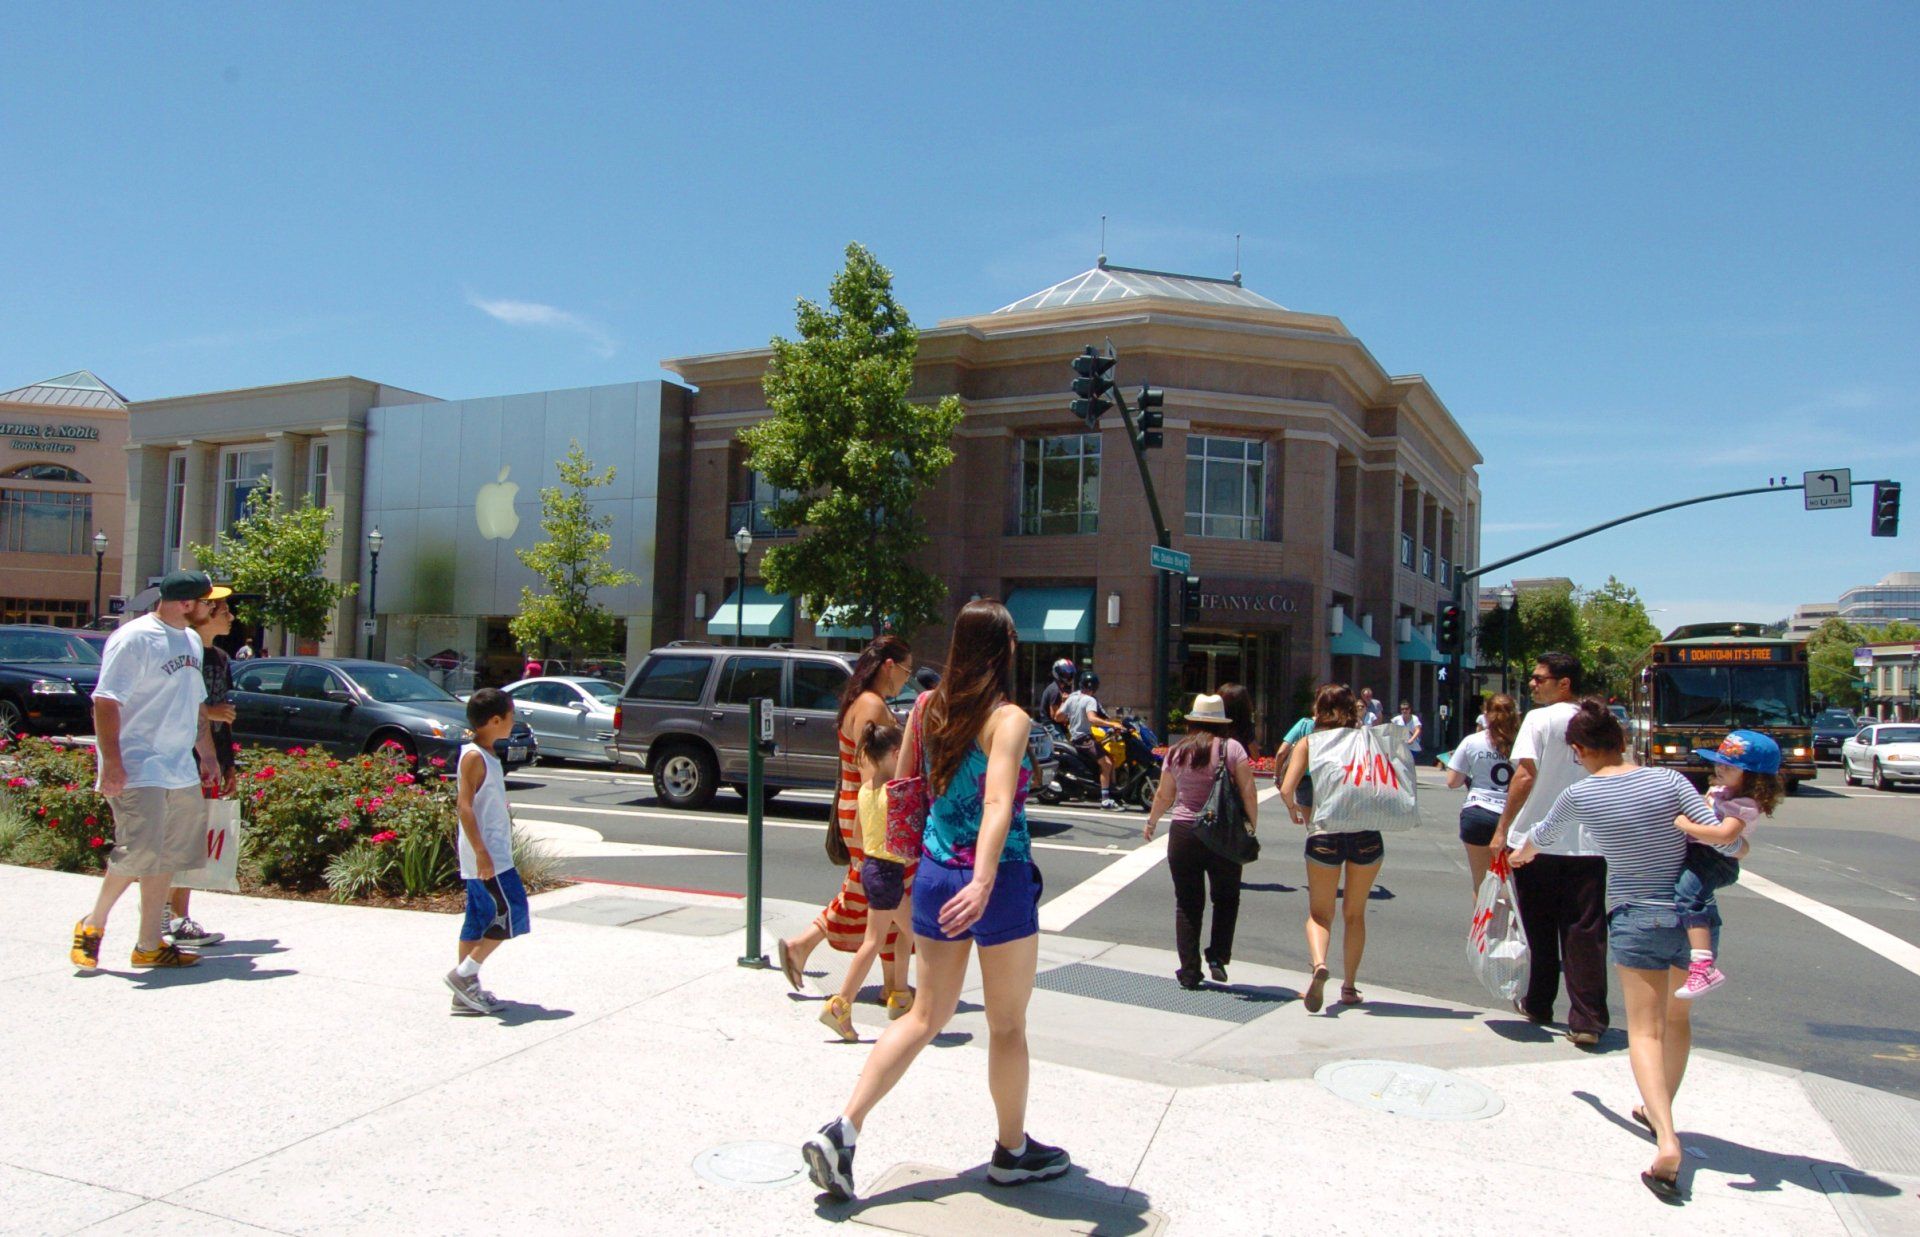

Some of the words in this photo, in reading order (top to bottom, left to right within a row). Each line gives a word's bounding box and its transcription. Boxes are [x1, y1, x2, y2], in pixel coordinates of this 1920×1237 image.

[0, 423, 39, 435] arnes
[42, 424, 53, 439] &
[59, 425, 99, 438] Noble
[10, 439, 76, 453] Booksellers
[1820, 498, 1828, 506] U
[1200, 594, 1251, 610] FFANY
[1253, 595, 1265, 611] &
[1678, 648, 1686, 661] 4
[1691, 649, 1733, 661] DOWNTOWN
[1734, 648, 1751, 661] IT'S
[1751, 648, 1772, 660] FREE
[1478, 751, 1507, 761] C.RON
[1343, 752, 1399, 790] HM
